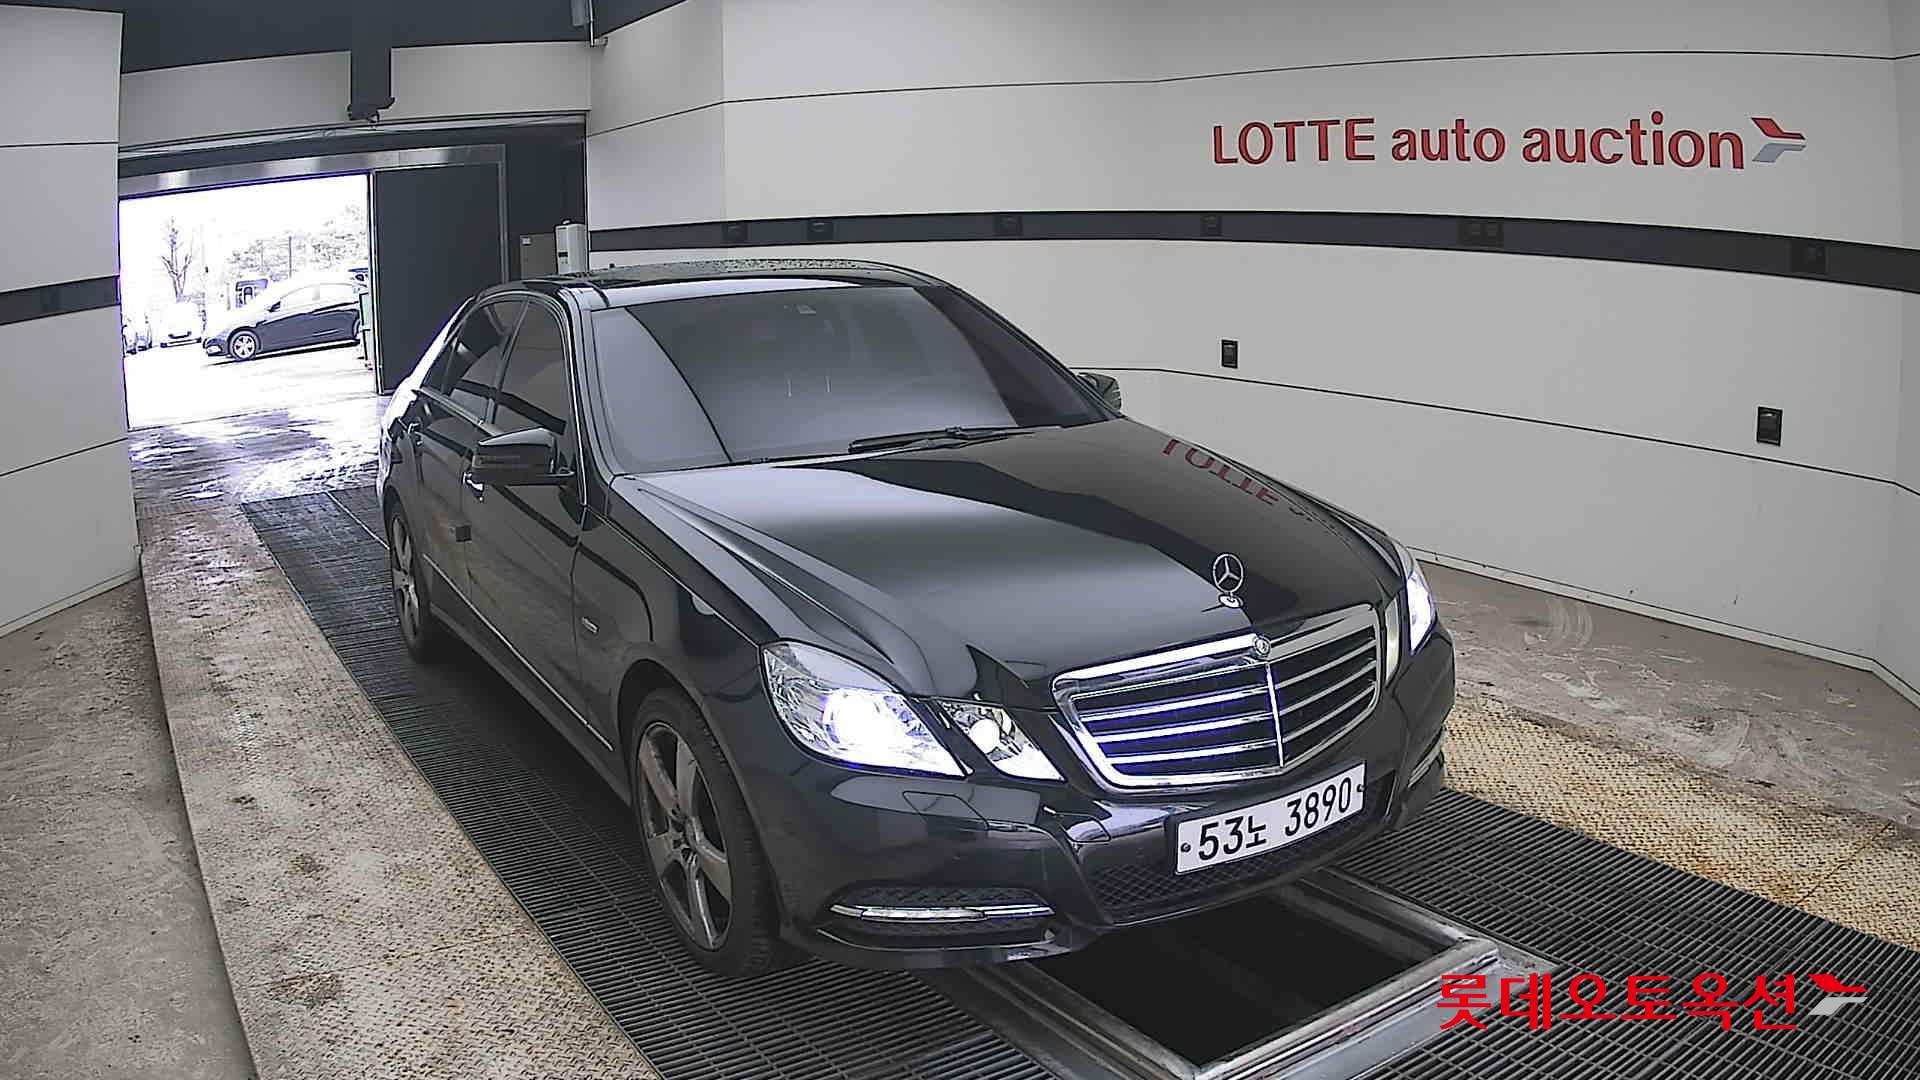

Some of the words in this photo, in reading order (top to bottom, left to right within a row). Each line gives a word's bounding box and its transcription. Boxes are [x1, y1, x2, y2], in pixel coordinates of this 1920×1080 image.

[1213, 117, 1376, 165] LOTTE
[1391, 118, 1507, 163] auto
[1522, 110, 1745, 170] auction
[1198, 815, 1267, 861] 53노
[1284, 776, 1352, 837] 3890
